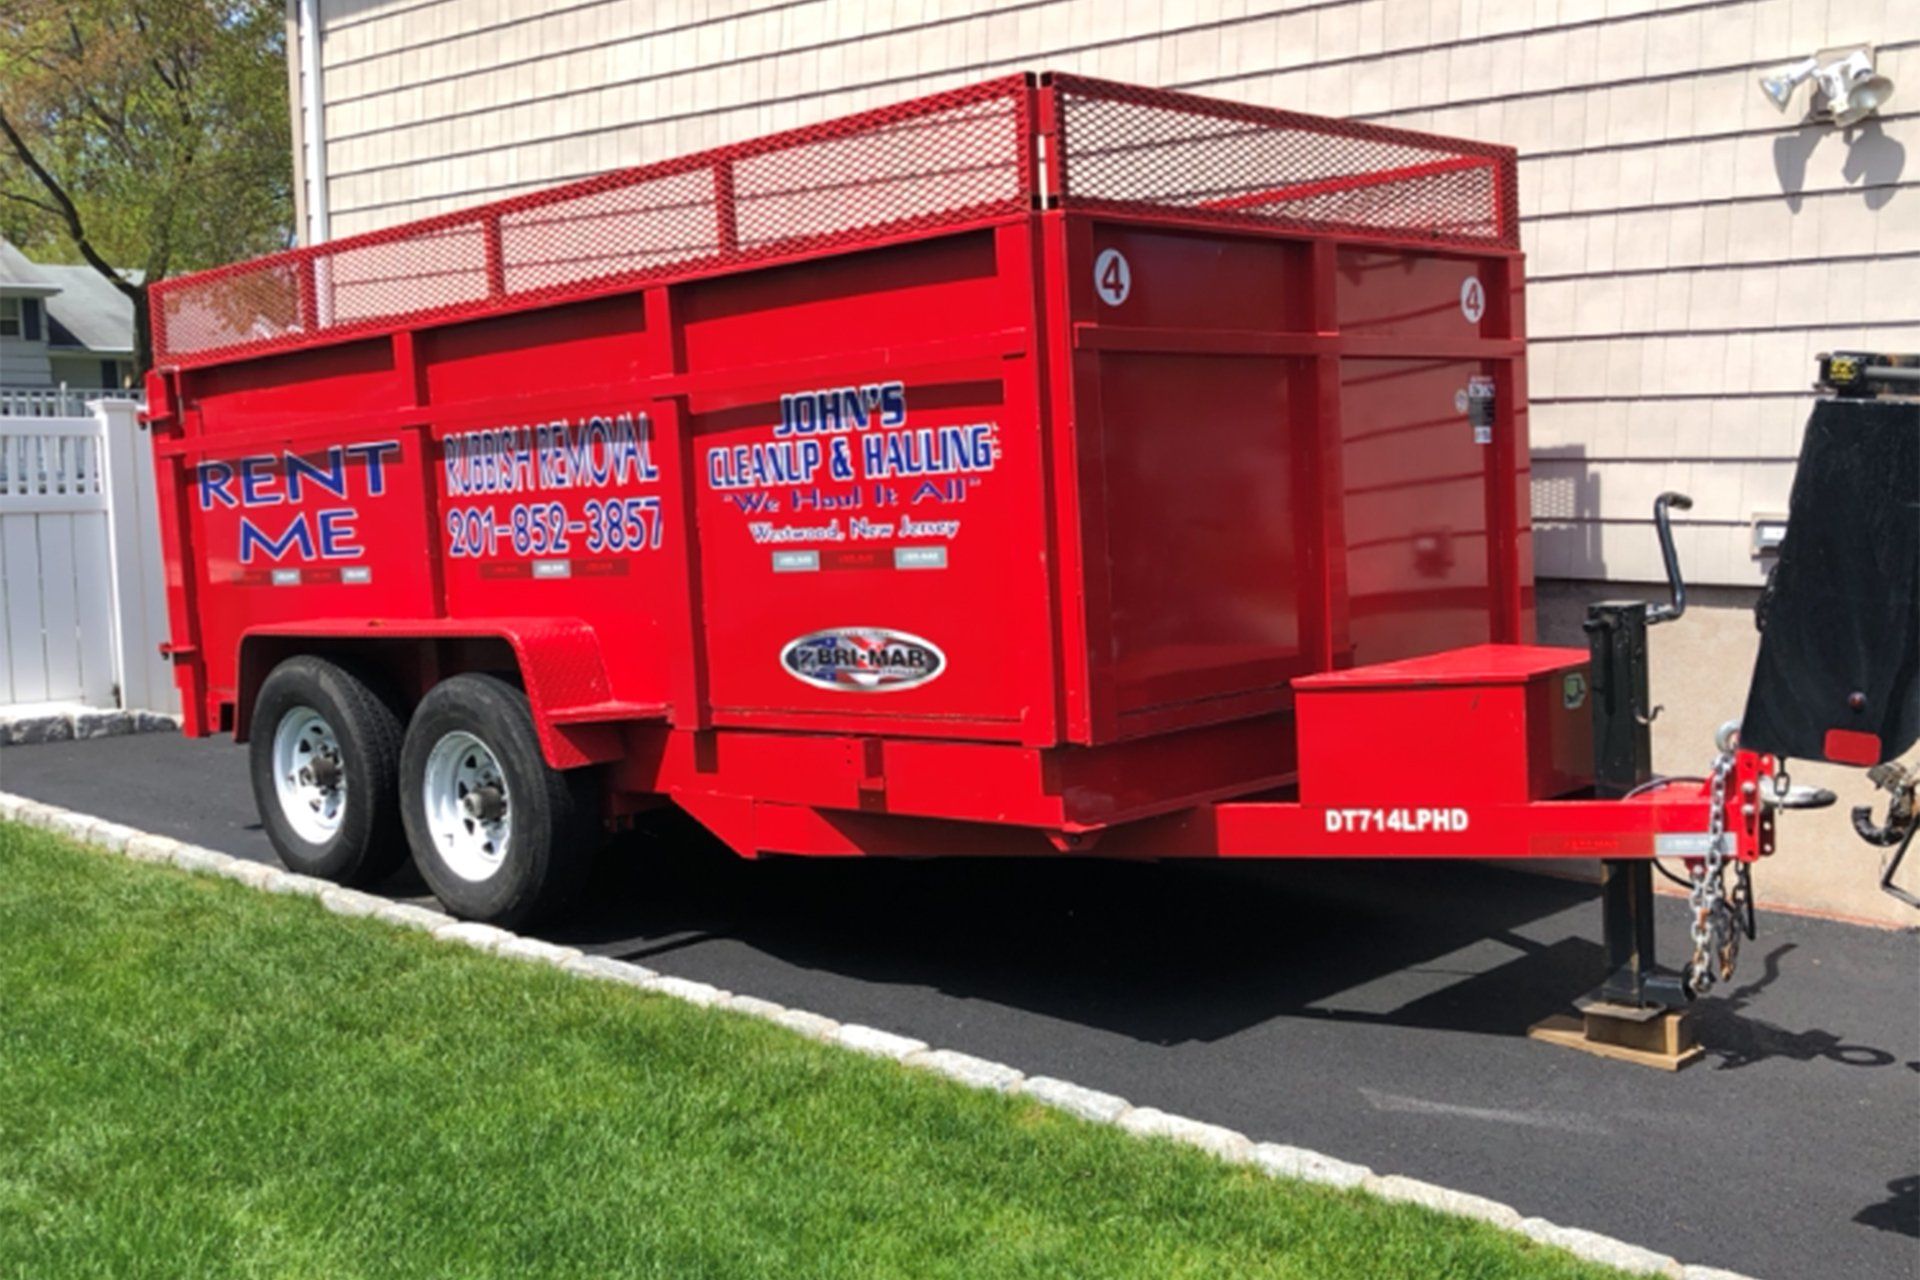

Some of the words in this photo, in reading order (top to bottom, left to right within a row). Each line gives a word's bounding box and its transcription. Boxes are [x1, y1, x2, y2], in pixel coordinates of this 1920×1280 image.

[1102, 255, 1124, 299] 4
[1464, 283, 1481, 316] 4
[774, 381, 905, 437] JOHN'S
[197, 441, 400, 510] RENT
[443, 426, 535, 497] RUBBISH
[536, 412, 659, 490] REMOVAL
[708, 437, 822, 490] CLEANUP
[830, 436, 854, 481] &
[863, 423, 995, 478] HAULING
[791, 485, 862, 511] Haul
[876, 483, 898, 507] It
[240, 510, 366, 564] ME
[448, 497, 664, 558] 201-852-3857
[749, 519, 845, 543] Westwood,
[850, 516, 893, 539] New
[898, 514, 960, 538] Jersey
[1325, 808, 1469, 832] DT714LPHD
